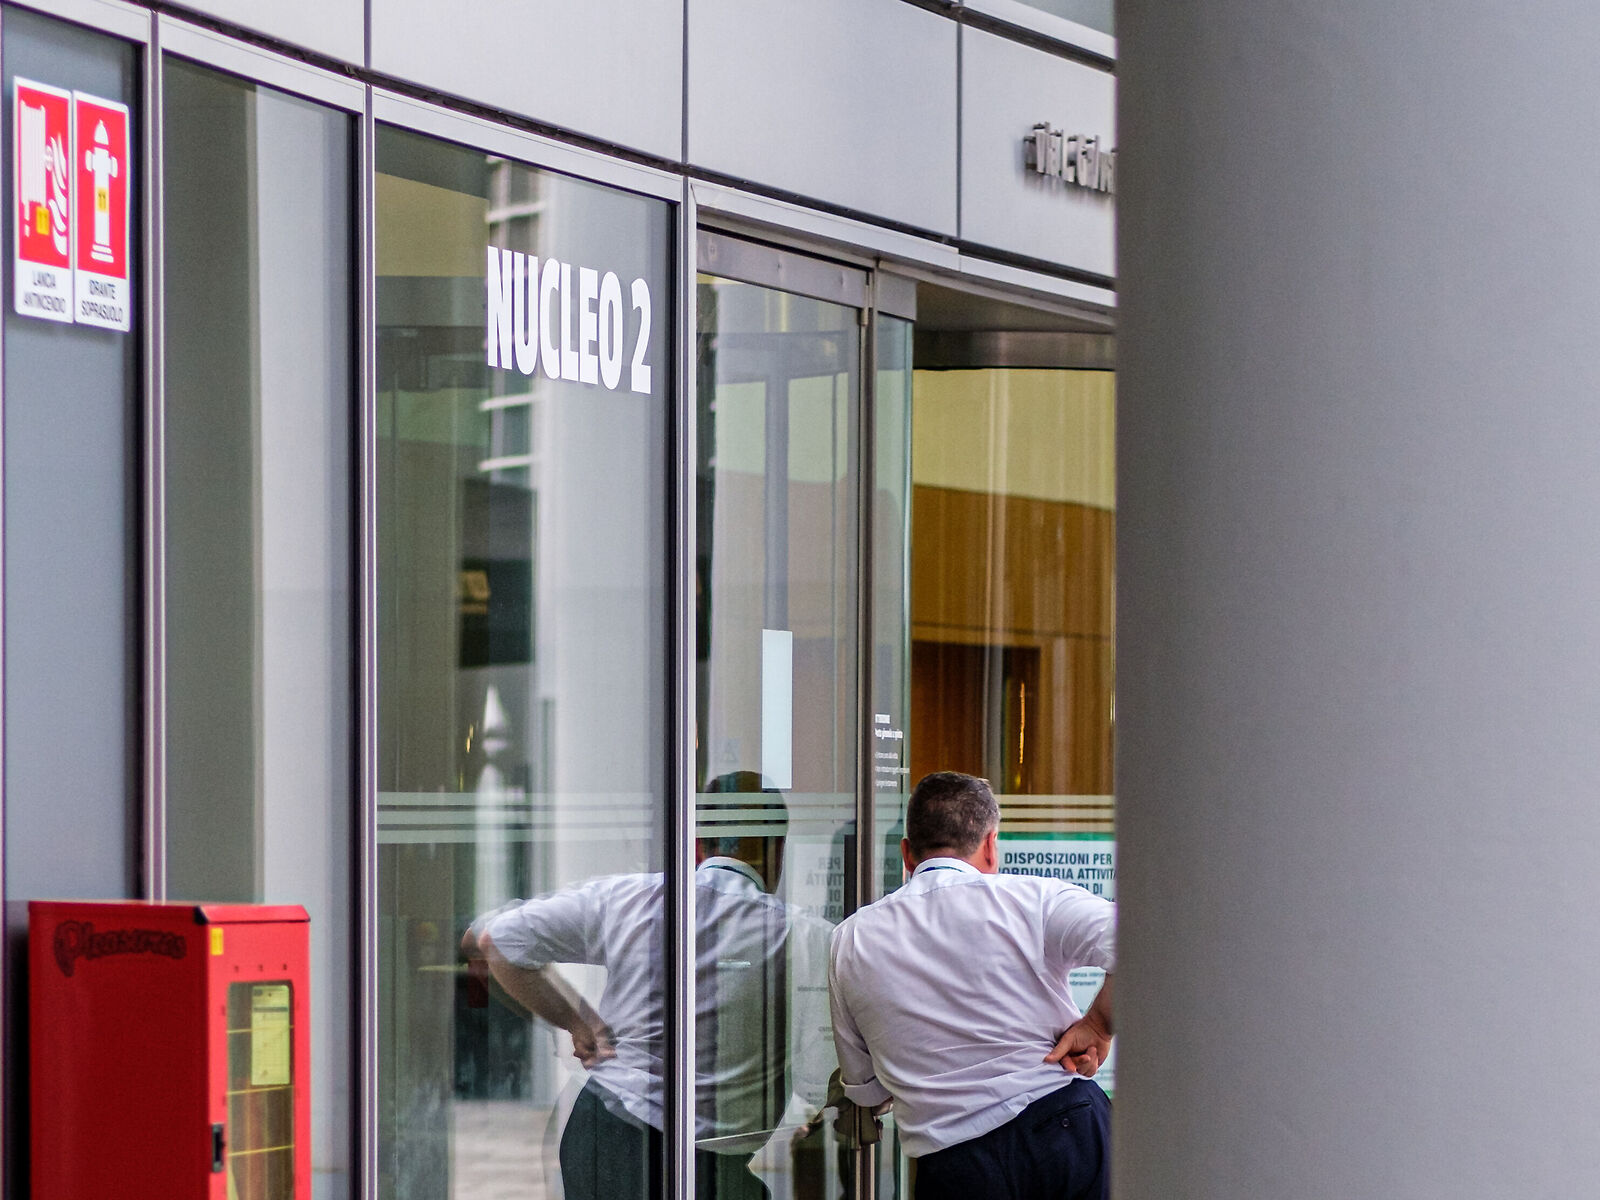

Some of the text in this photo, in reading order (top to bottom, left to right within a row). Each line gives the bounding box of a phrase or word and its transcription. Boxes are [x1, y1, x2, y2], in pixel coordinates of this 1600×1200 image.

[487, 246, 652, 394] NUCLEO 2
[1004, 852, 1112, 865] DISPOSIZIONI PER
[1093, 883, 1103, 894] DI
